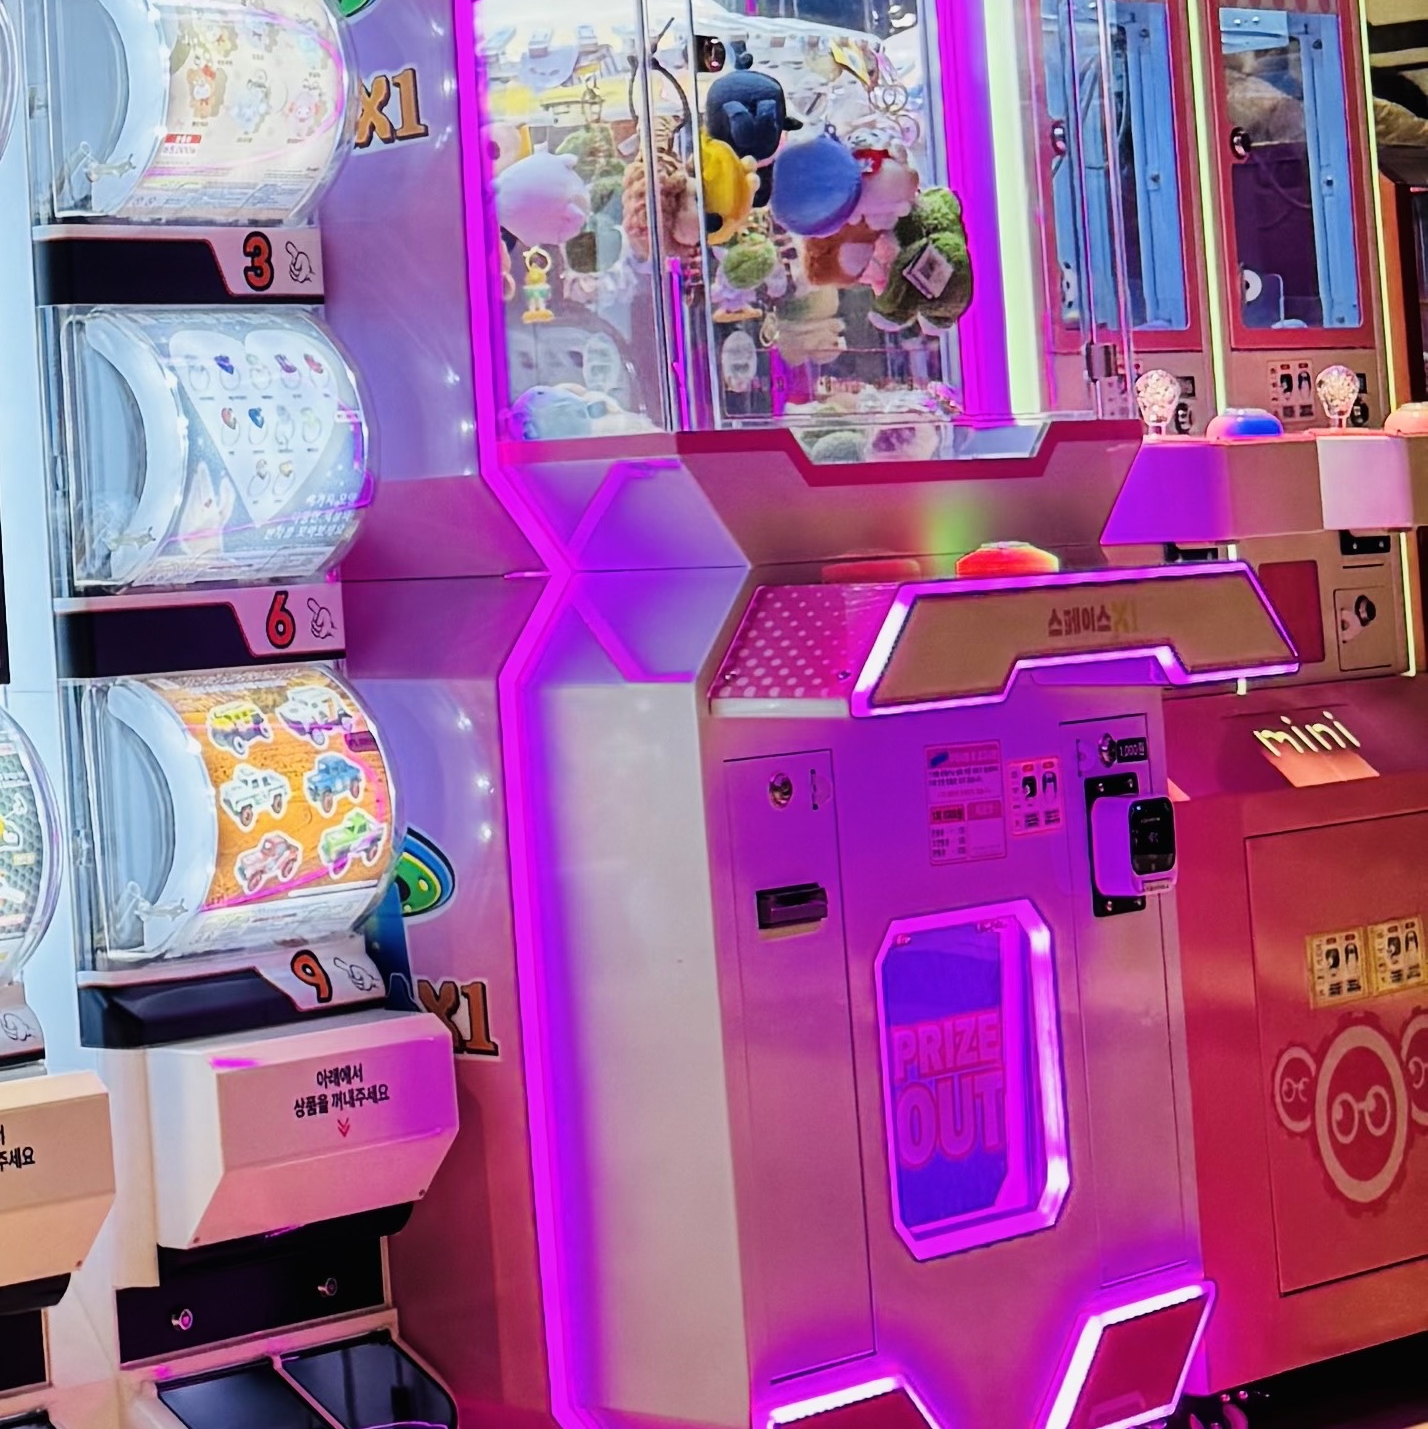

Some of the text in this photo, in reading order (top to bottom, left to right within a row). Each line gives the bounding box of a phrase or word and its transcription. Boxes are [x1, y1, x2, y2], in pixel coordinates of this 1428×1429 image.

[242, 231, 275, 291] 3
[265, 590, 297, 649] 6
[1252, 711, 1362, 756] mini
[290, 950, 331, 1004] 9
[892, 1016, 1001, 1081] PRIZE
[292, 1081, 391, 1120] 상품을 꺼내주세요
[315, 1064, 364, 1091] 아래에서
[896, 1077, 1006, 1167] OUT
